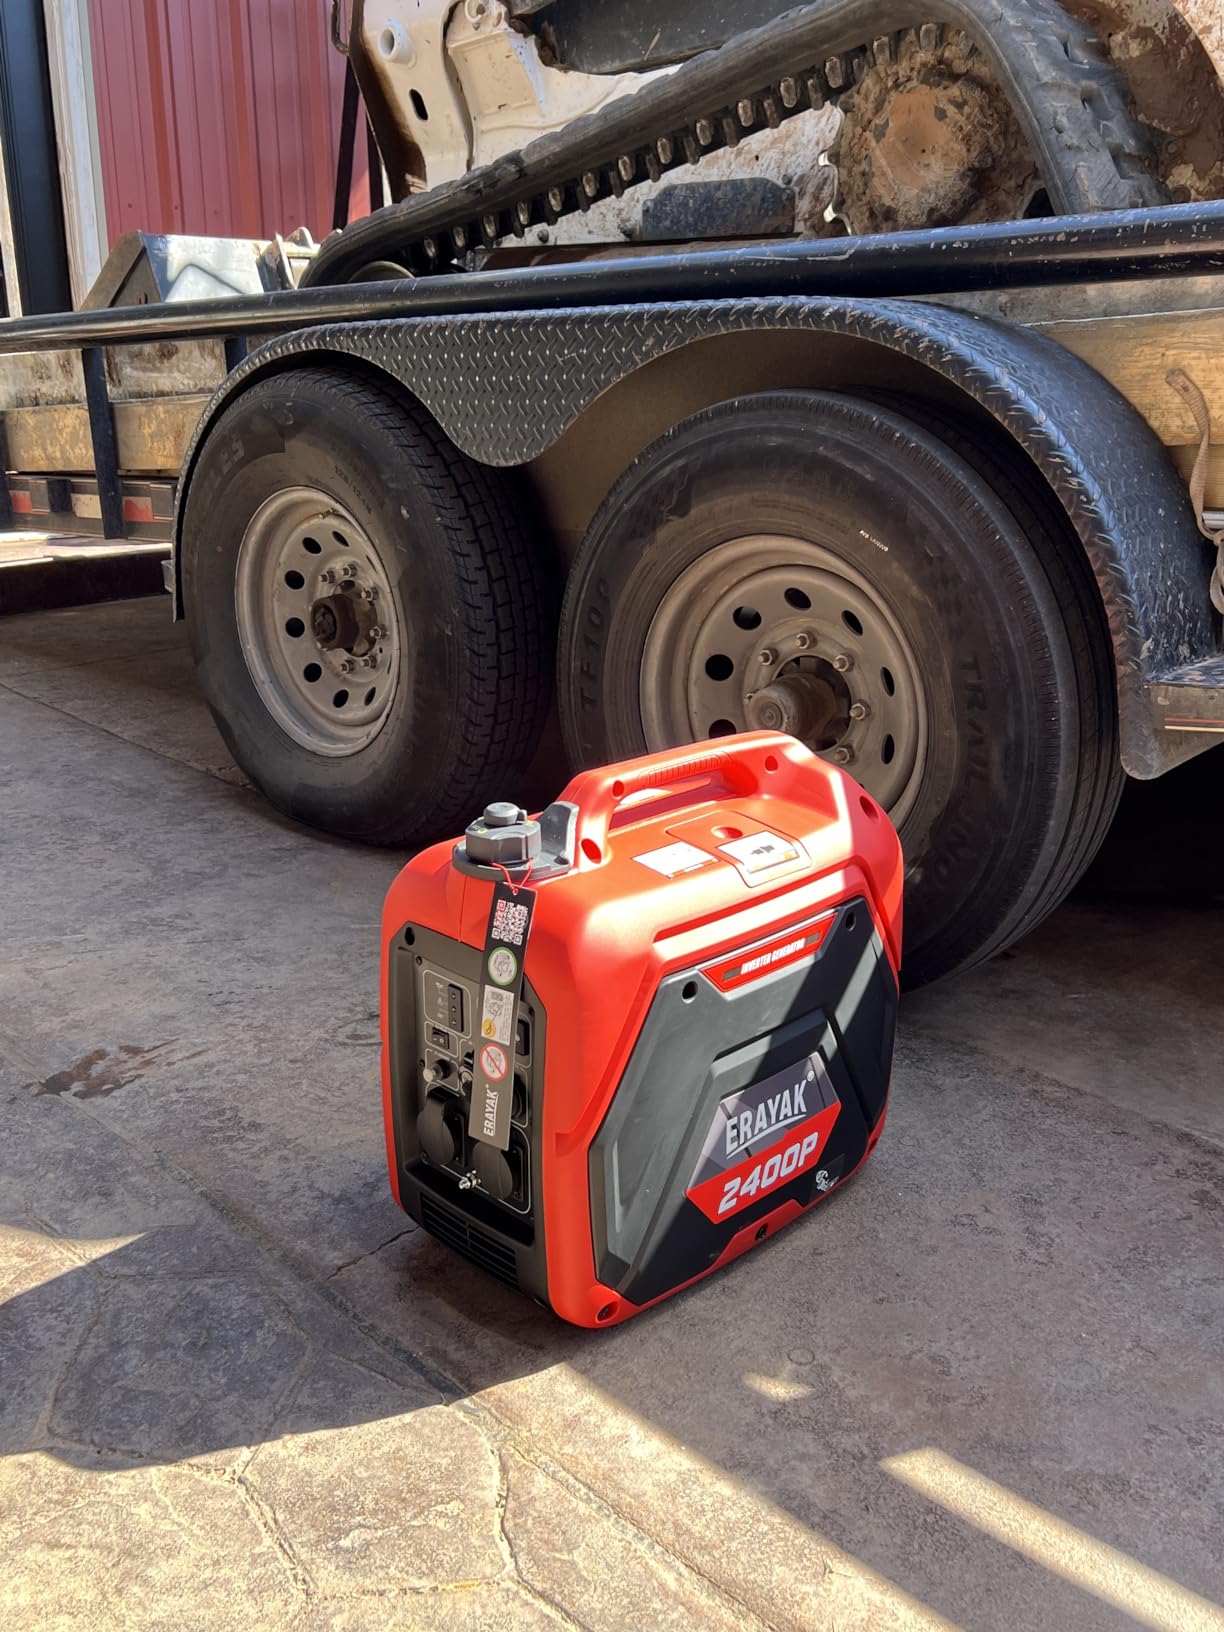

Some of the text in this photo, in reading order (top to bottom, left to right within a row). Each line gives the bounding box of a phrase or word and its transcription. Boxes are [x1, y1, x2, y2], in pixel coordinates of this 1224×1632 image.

[740, 938, 806, 975] INVERTER GENERATOR
[717, 1131, 820, 1216] 2400P
